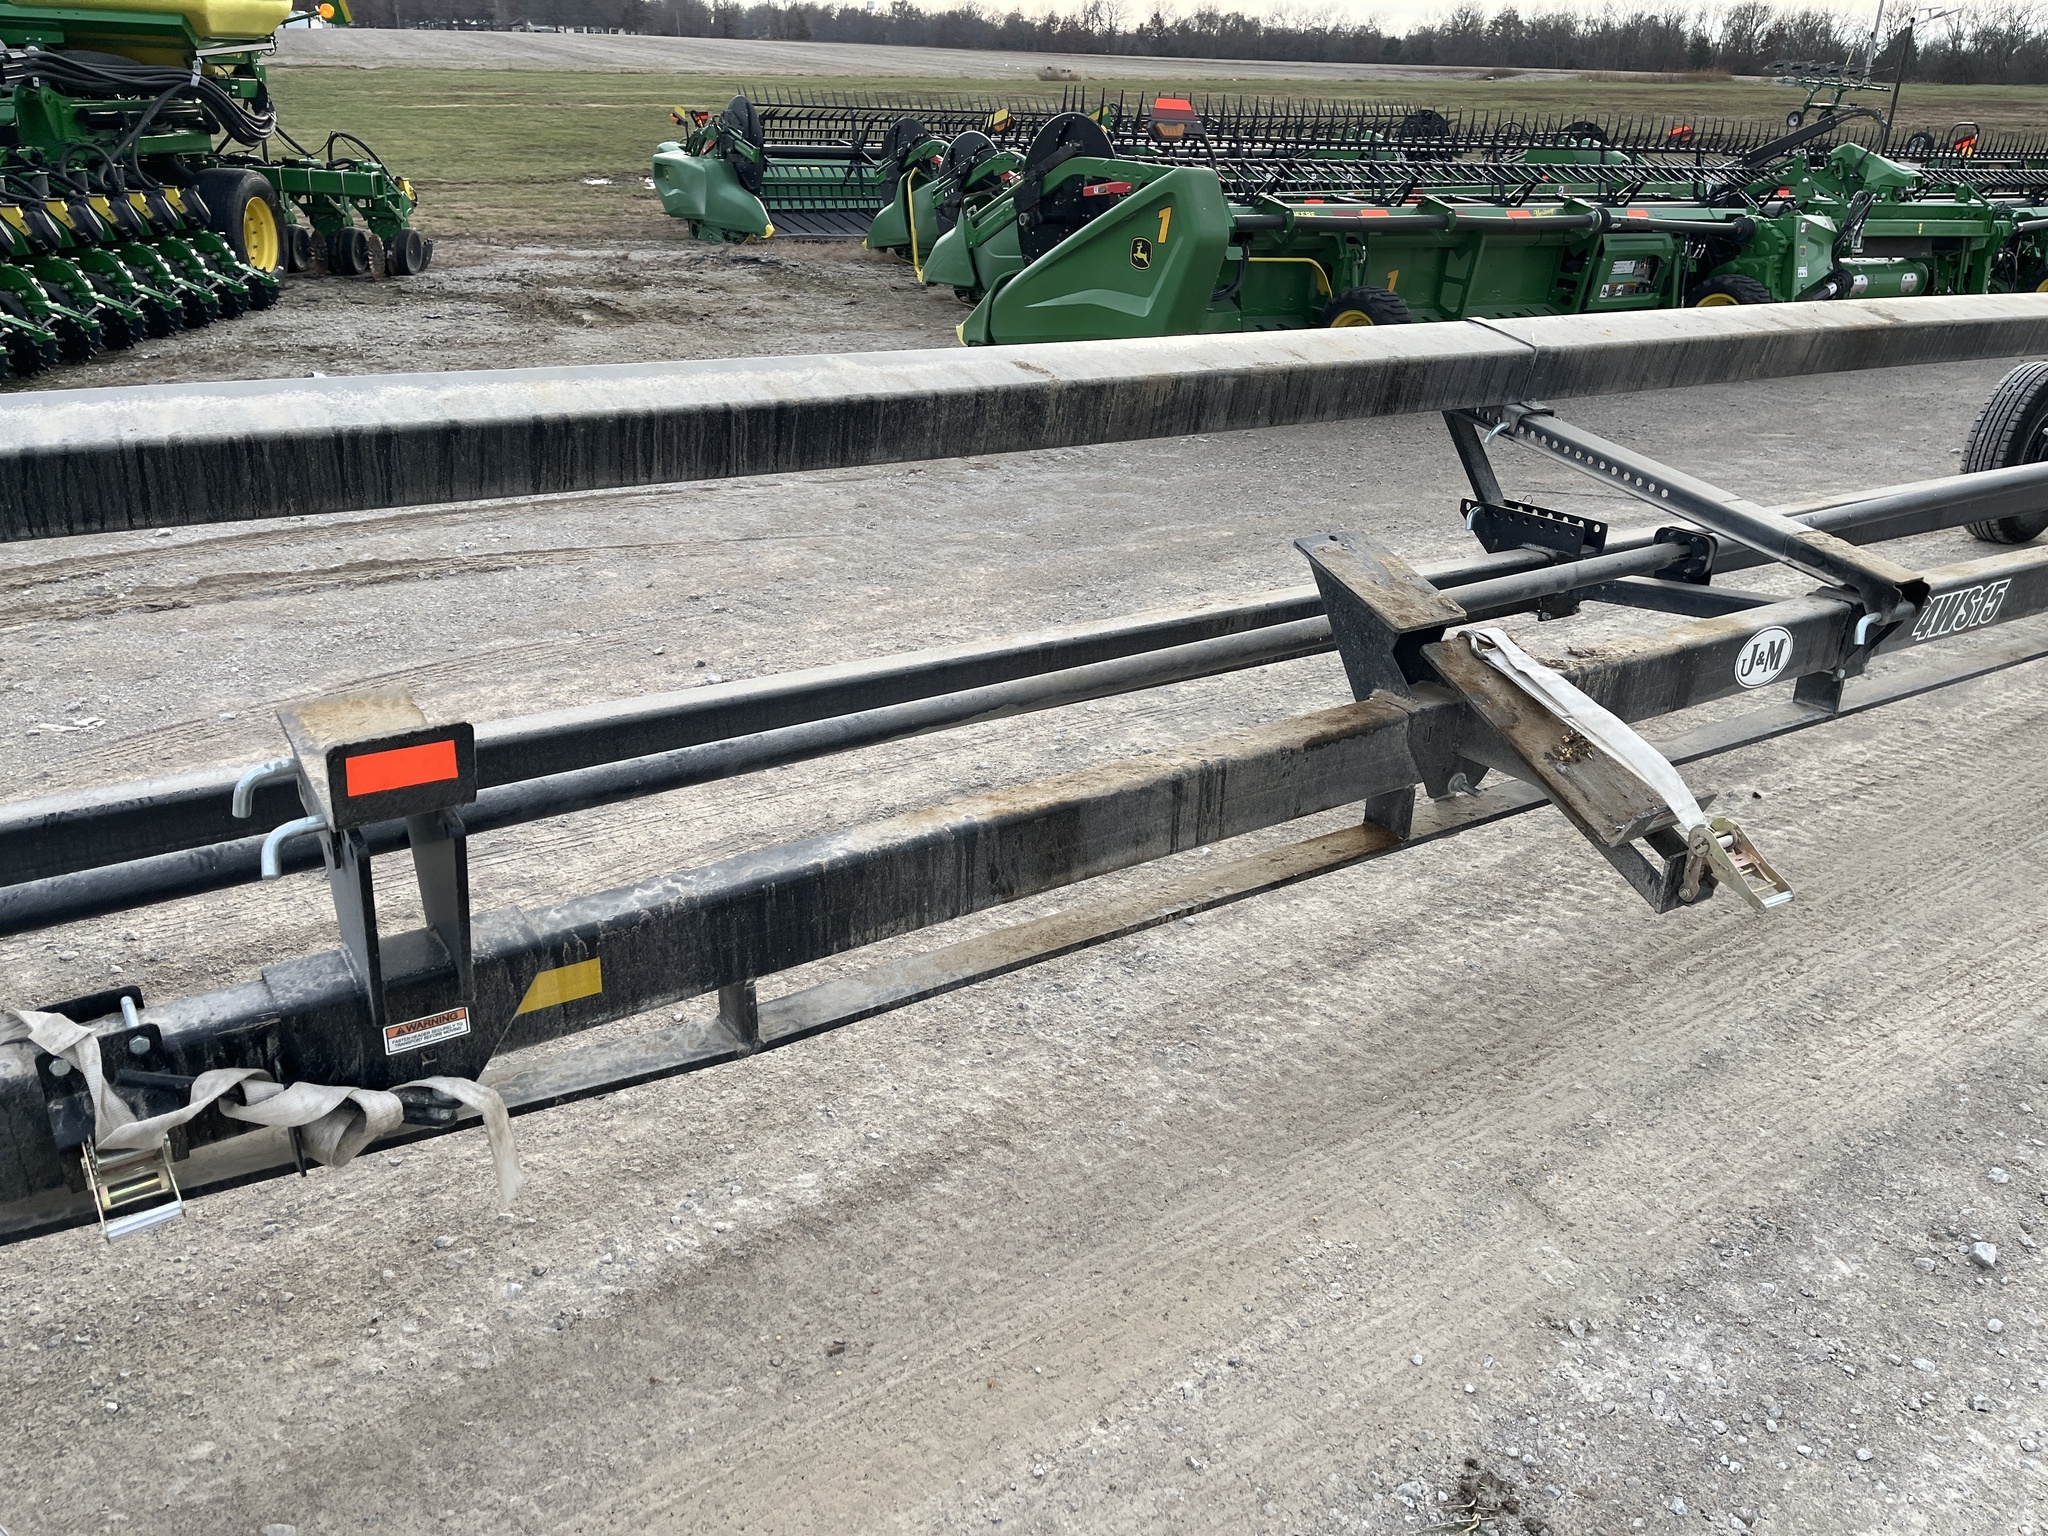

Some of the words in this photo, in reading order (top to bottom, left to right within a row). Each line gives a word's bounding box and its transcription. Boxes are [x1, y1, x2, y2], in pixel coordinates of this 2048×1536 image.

[1157, 206, 1172, 243] 1
[1387, 269, 1400, 292] 1
[1911, 578, 2011, 641] 4WS15
[1741, 638, 1786, 677] J&M
[406, 1012, 458, 1032] WARNING
[392, 1036, 411, 1045] FASTEN
[412, 1031, 430, 1040] HEADER
[432, 1024, 455, 1035] SECURELY
[395, 1038, 423, 1048] TRANSPORT
[424, 1032, 442, 1041] BEFORE
[443, 1027, 462, 1035] MOVING
